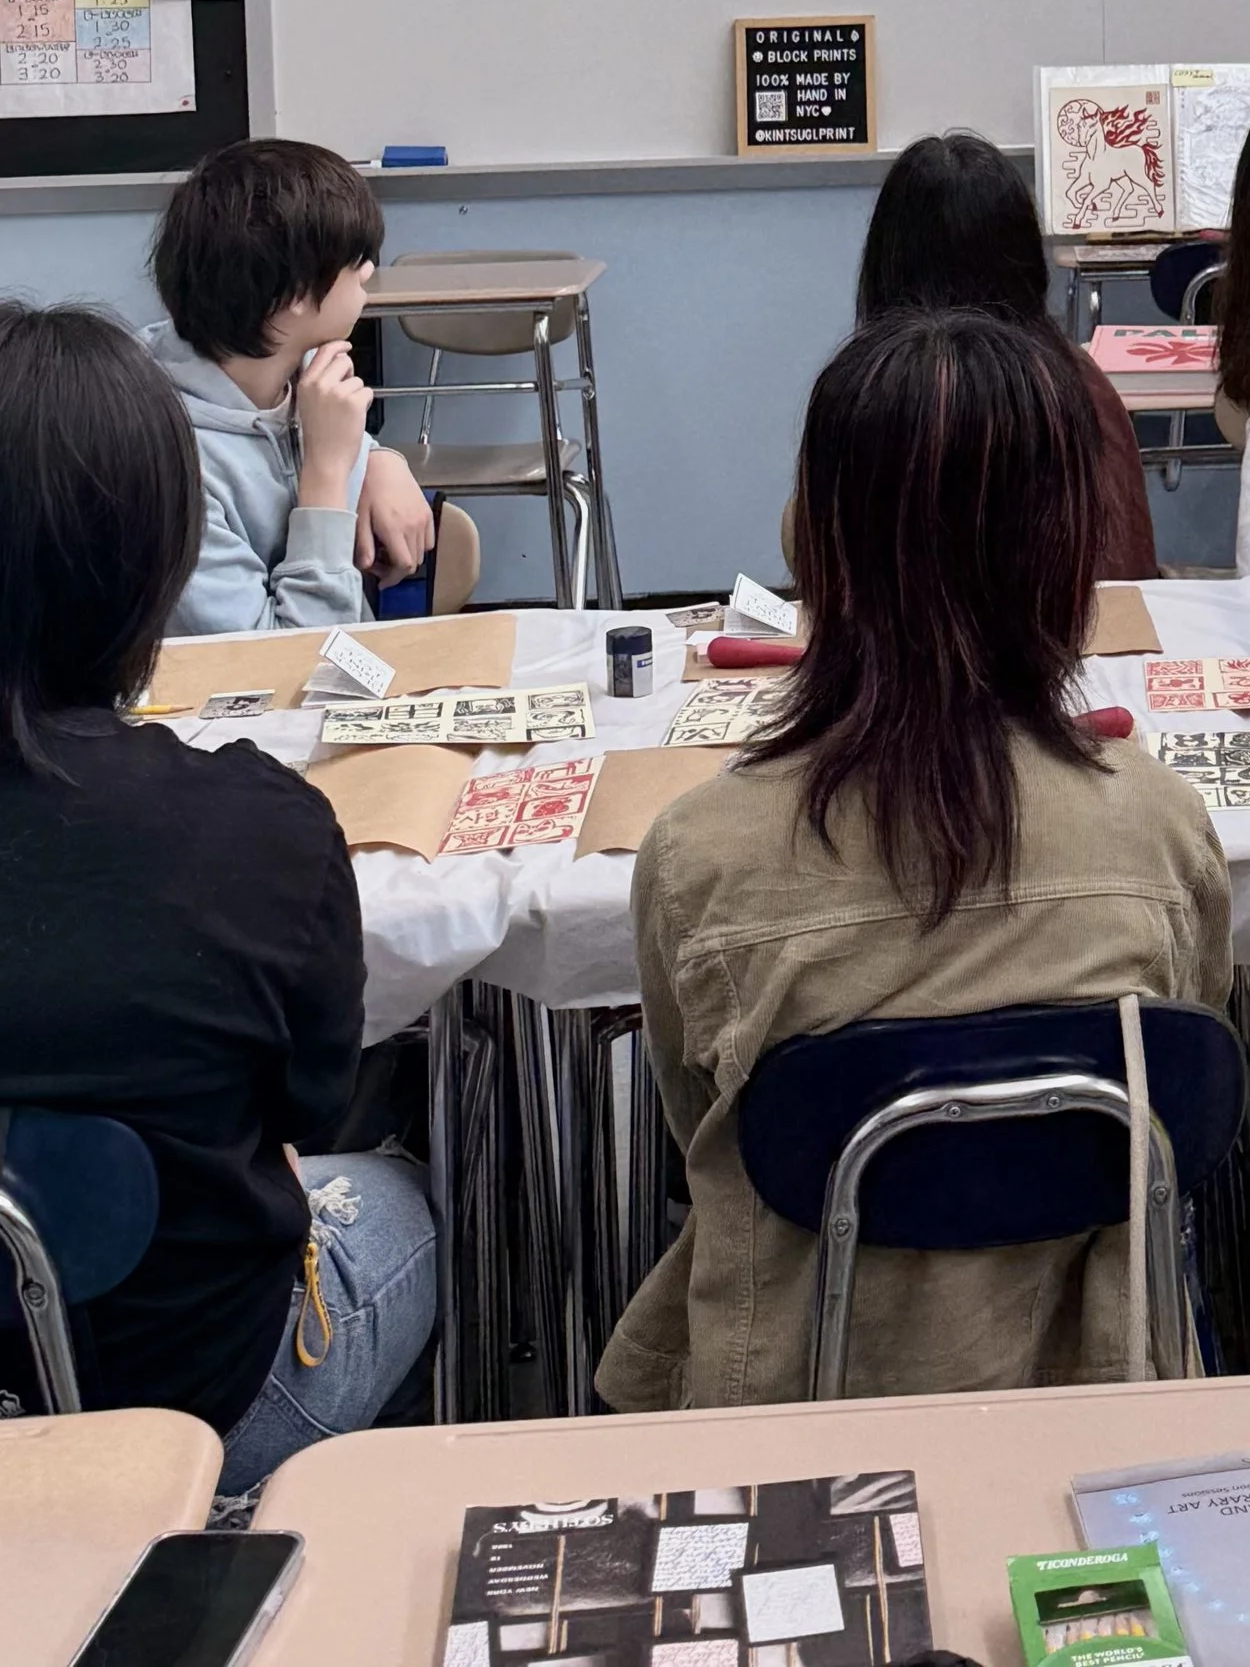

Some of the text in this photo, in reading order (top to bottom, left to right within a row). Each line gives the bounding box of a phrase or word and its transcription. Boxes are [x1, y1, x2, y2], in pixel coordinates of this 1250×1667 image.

[755, 29, 845, 44] ORIGINAL
[767, 49, 857, 63] BLOCK PRINTS
[756, 72, 851, 86] 100% MADE BY
[797, 88, 847, 101] HAND IN
[796, 105, 820, 117] NYC
[1167, 1500, 1201, 1514] ART
[1036, 1552, 1129, 1571] TICONDEROGA
[1071, 1646, 1144, 1662] THE WORLD'S
[1075, 1659, 1101, 1667] BEST
